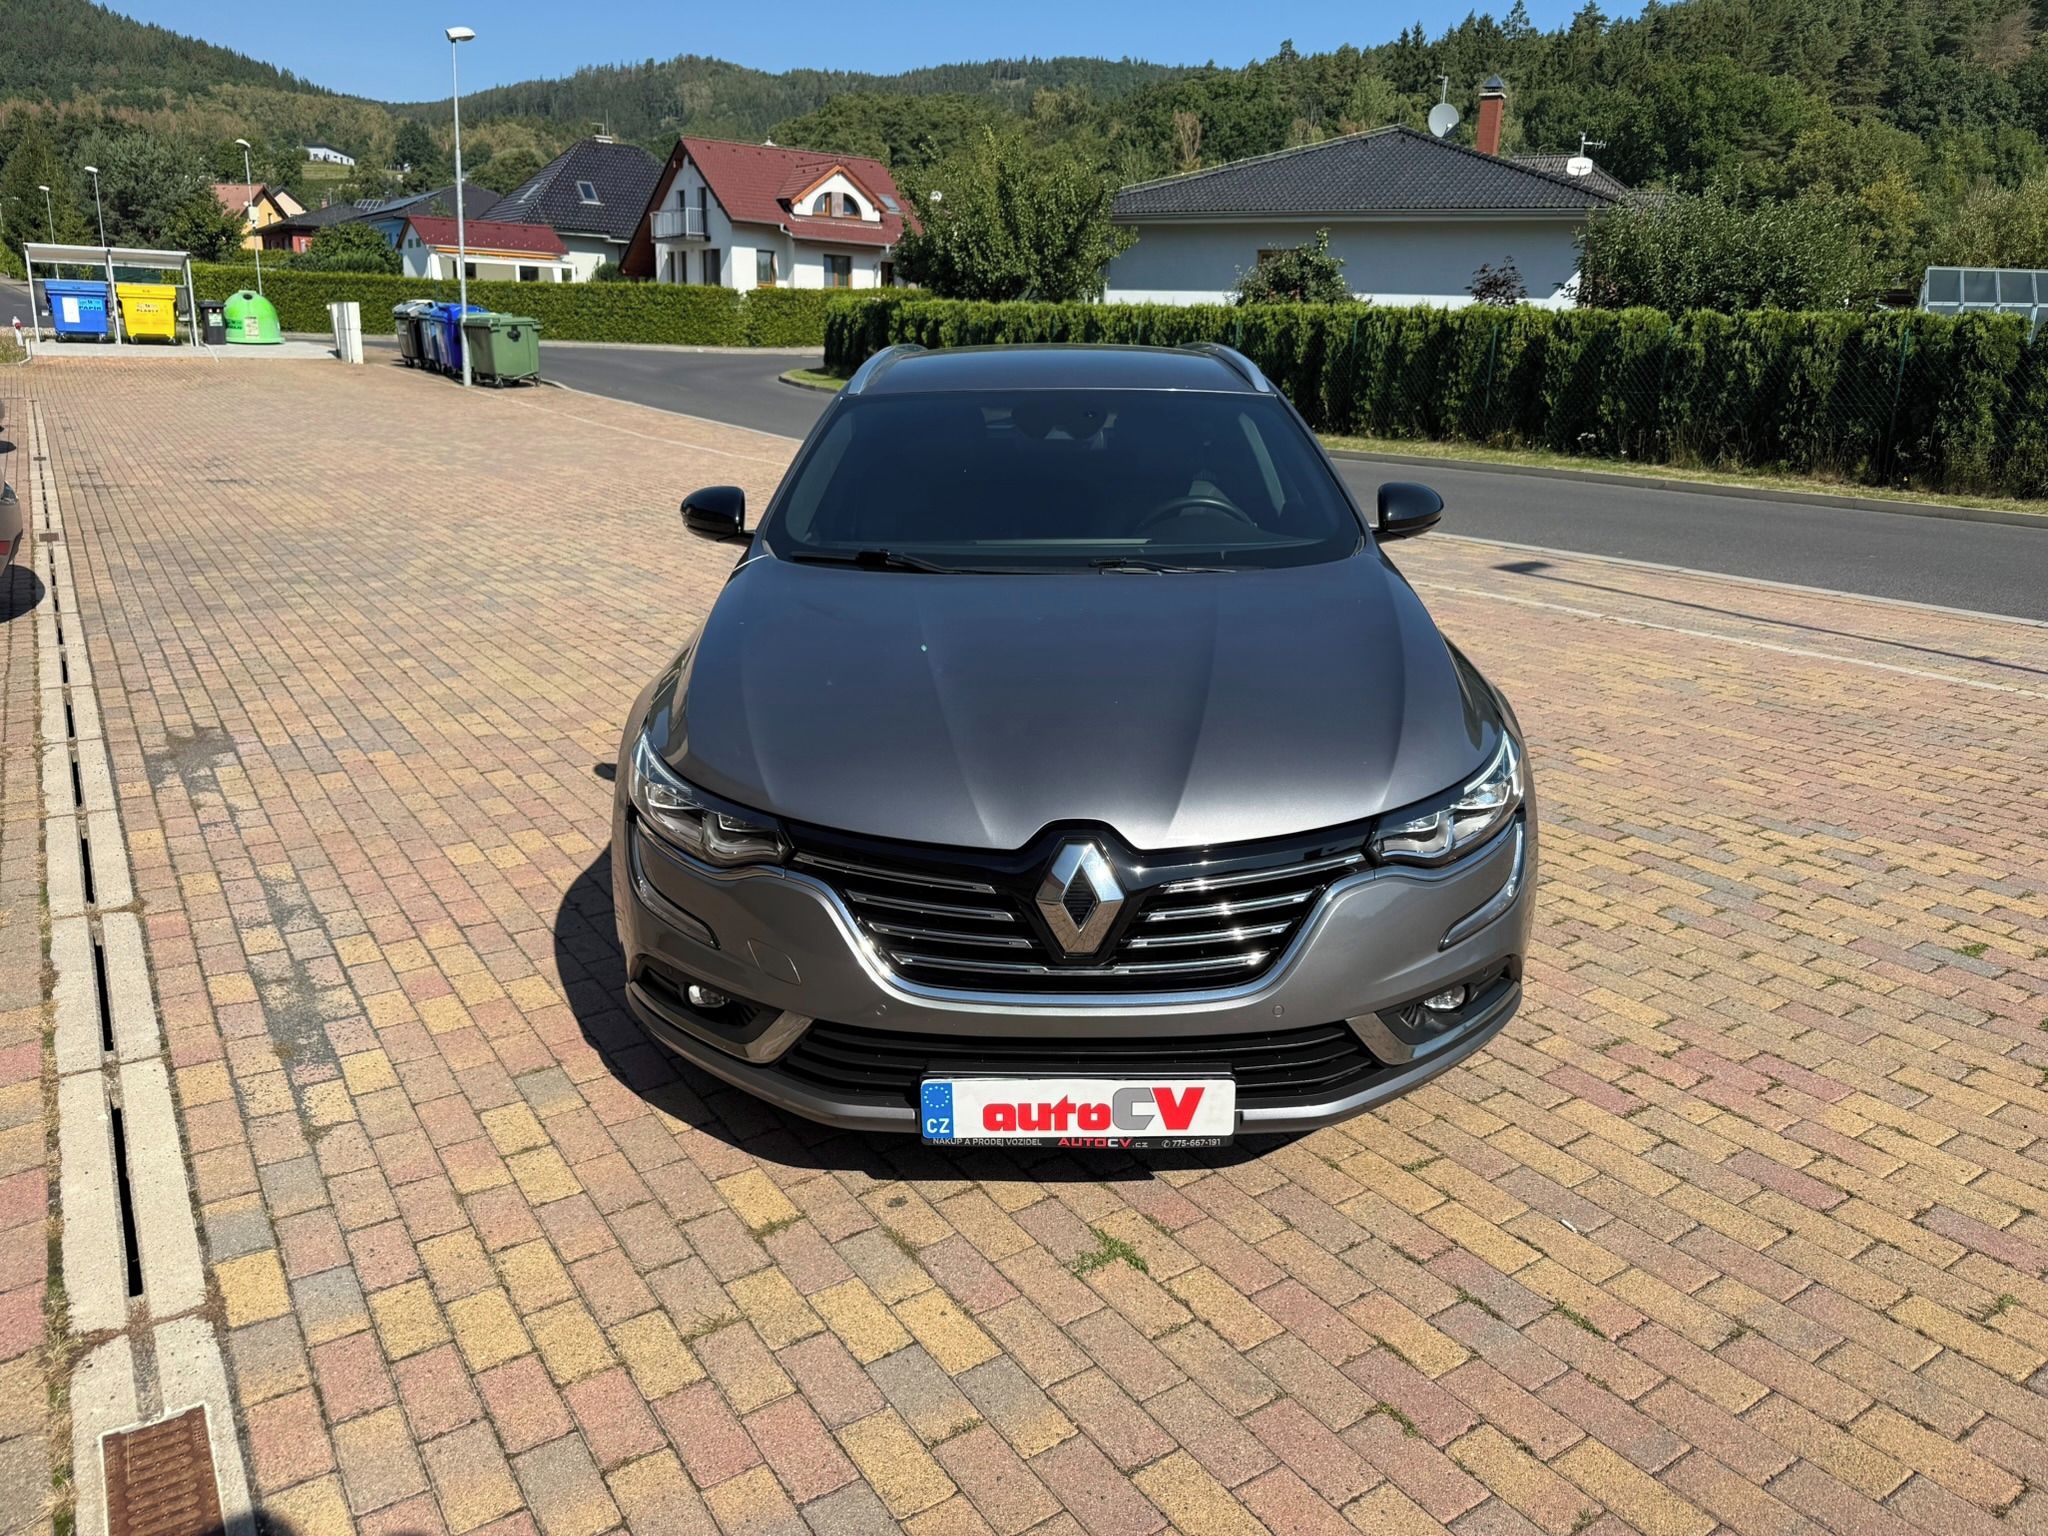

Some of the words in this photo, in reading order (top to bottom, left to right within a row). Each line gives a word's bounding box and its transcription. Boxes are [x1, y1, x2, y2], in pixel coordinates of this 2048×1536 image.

[982, 1087, 1205, 1131] autoCV
[926, 1118, 950, 1134] CZ
[972, 1138, 1004, 1146] PRODEJ
